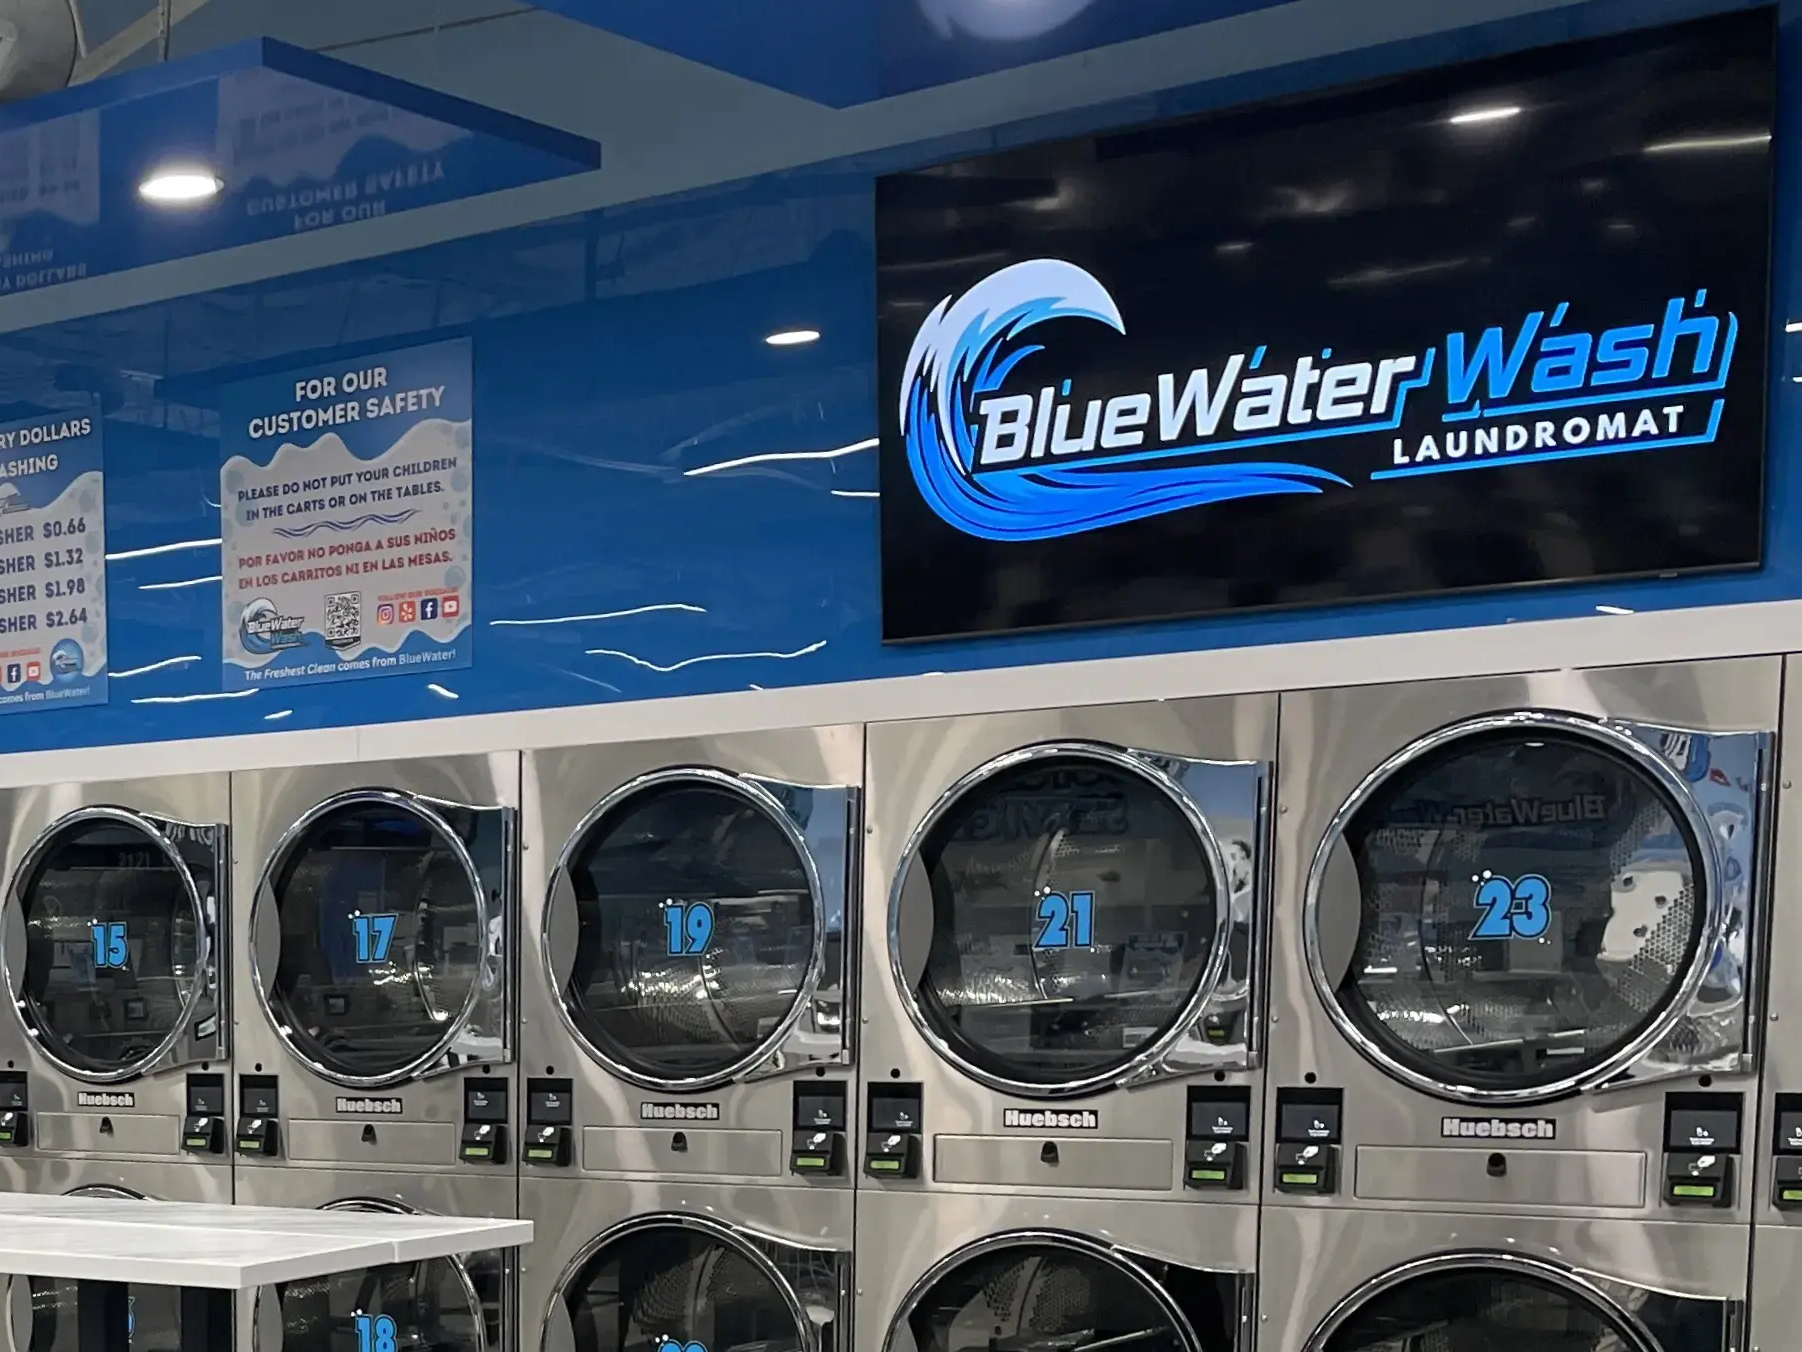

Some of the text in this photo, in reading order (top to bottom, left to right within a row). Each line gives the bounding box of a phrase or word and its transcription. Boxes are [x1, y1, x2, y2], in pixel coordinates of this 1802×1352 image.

[296, 367, 387, 402] FOR OUR
[979, 294, 1719, 464] BlueWater Wash
[249, 385, 445, 439] CUSTOMER SAFETY
[20, 418, 91, 446] DOLLARS
[1393, 405, 1685, 464] LAUNDROMAT
[238, 457, 458, 501] PLEASE DO NOT PUT YOUR CHILDREN
[246, 508, 259, 521] IN
[262, 504, 283, 519] THE
[286, 495, 325, 515] CARTS
[328, 494, 346, 509] OR
[349, 490, 367, 505] ON
[370, 486, 393, 502] THE
[43, 516, 86, 540] $0.66
[45, 548, 83, 569] $1.32
[239, 527, 456, 569] POR FAVOR NO PONGA A SUS NIÑOS
[45, 578, 85, 598] $1.98
[238, 577, 253, 589] EN
[256, 574, 279, 587] LOS
[282, 566, 342, 585] CARRITOS
[345, 563, 360, 576] NI
[363, 561, 378, 573] EN
[381, 557, 404, 571] LAS
[46, 608, 88, 629] $2.64
[247, 616, 304, 633] BlueWater
[245, 649, 456, 681] The Freshest Clean comes from BlueWater!
[1036, 891, 1094, 949] 21
[1474, 875, 1550, 940] 23
[92, 922, 129, 968] 15
[352, 914, 397, 963] 17
[662, 902, 715, 956] 19
[78, 1092, 134, 1106] Huebsch
[336, 1097, 401, 1114] Huebsch
[642, 1104, 719, 1120] Huebsch
[1005, 1110, 1097, 1128] Huebsch
[1443, 1118, 1554, 1139] Huebsch
